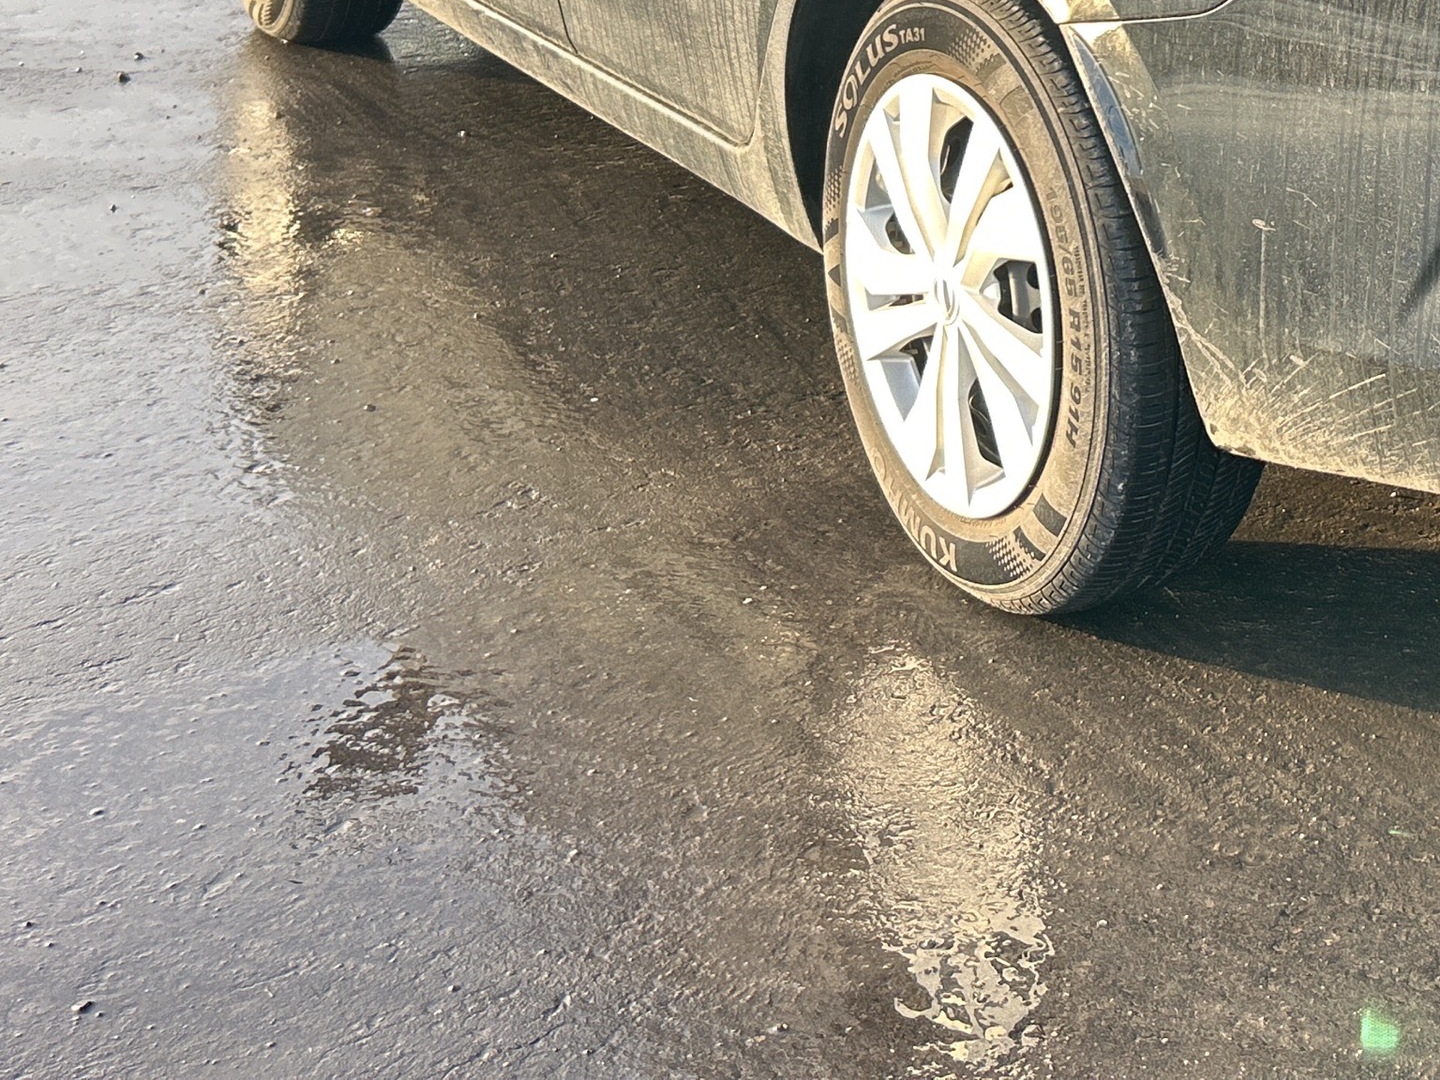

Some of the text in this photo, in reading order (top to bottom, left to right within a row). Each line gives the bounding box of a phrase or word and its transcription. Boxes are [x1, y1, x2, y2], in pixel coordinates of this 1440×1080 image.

[834, 23, 899, 139] SOLUS
[898, 27, 925, 44] TA31
[1068, 307, 1083, 376] R15
[1065, 381, 1081, 449] 91H
[867, 446, 958, 573] KUMHO
